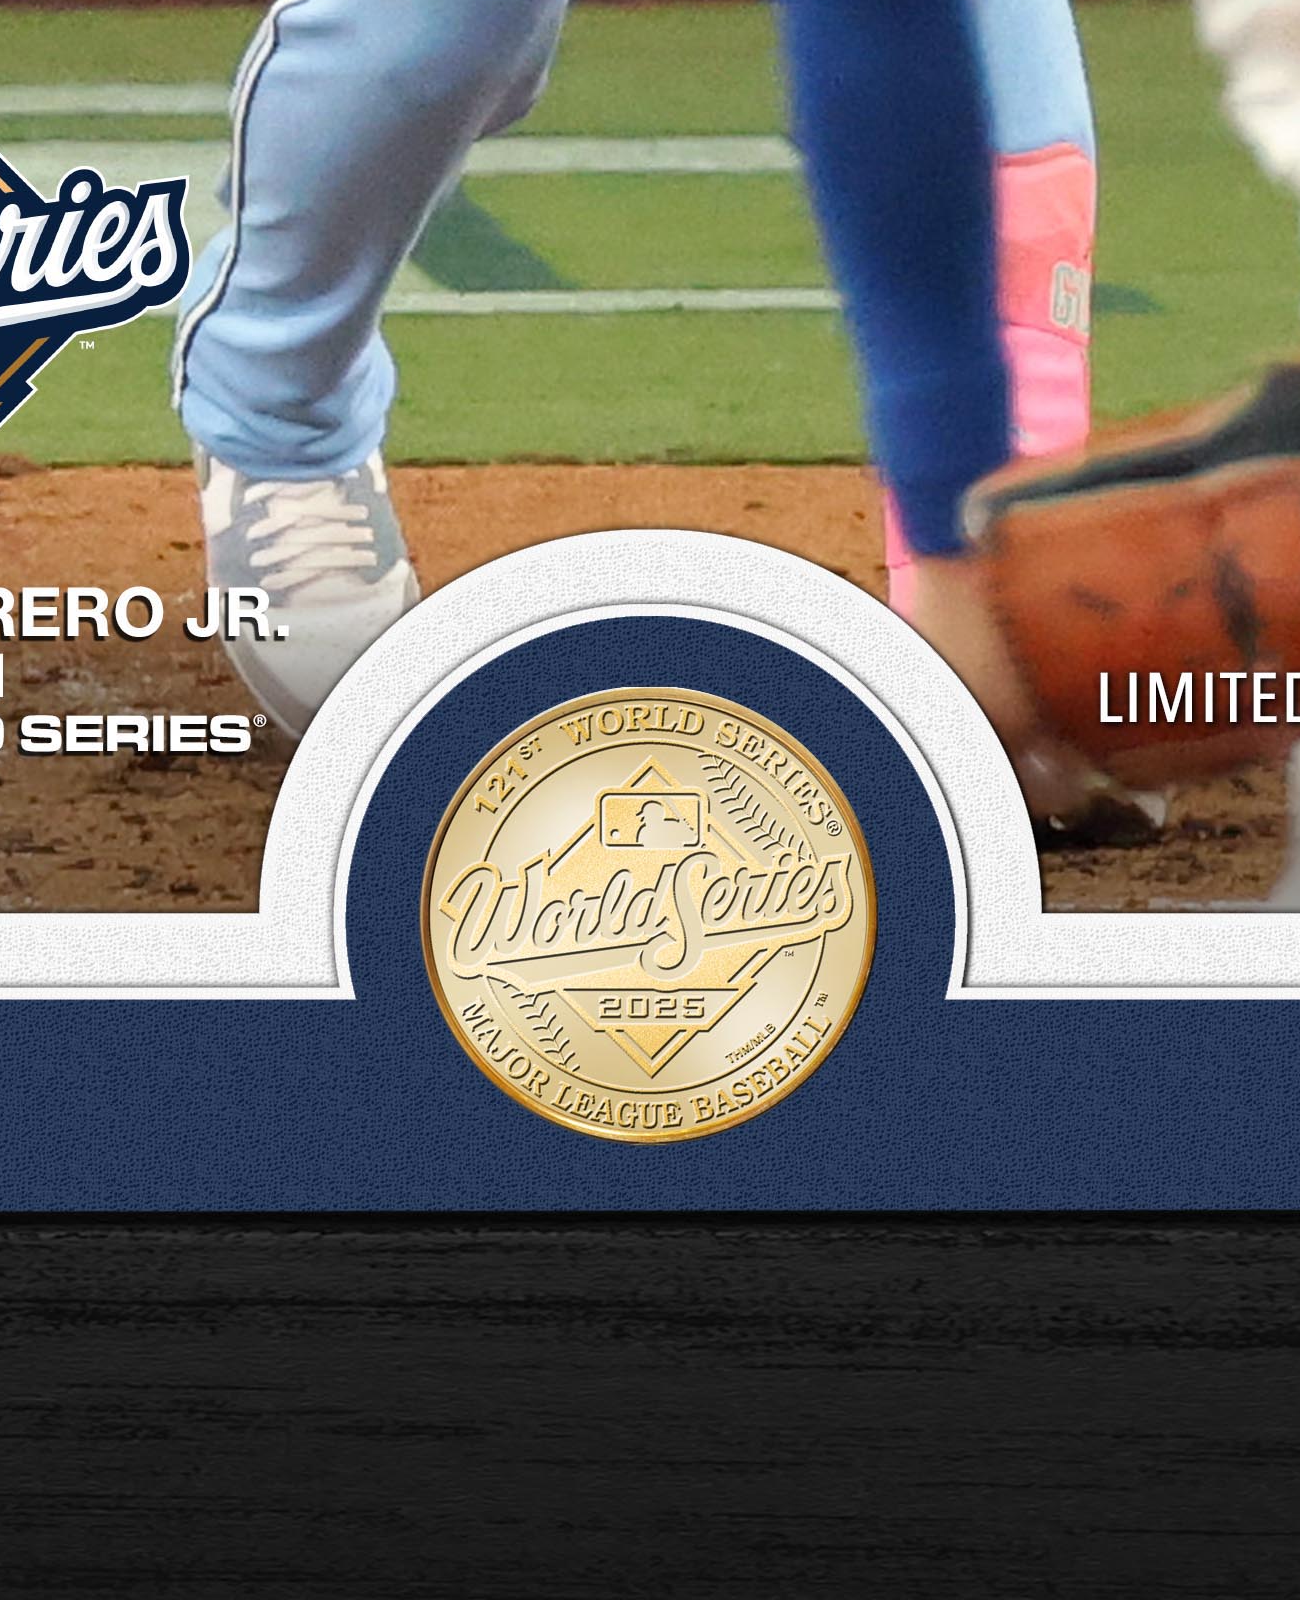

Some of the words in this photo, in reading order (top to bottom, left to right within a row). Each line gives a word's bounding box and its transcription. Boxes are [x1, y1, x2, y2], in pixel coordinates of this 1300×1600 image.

[559, 703, 705, 746] WORLD
[450, 850, 679, 959] World
[638, 850, 848, 981] Series
[598, 994, 706, 1020] 2025
[462, 998, 552, 1098] MAJOR
[553, 1080, 684, 1129] LEAGUE
[694, 1015, 831, 1123] BASEBALL
[725, 1021, 777, 1067] THM/MLB
